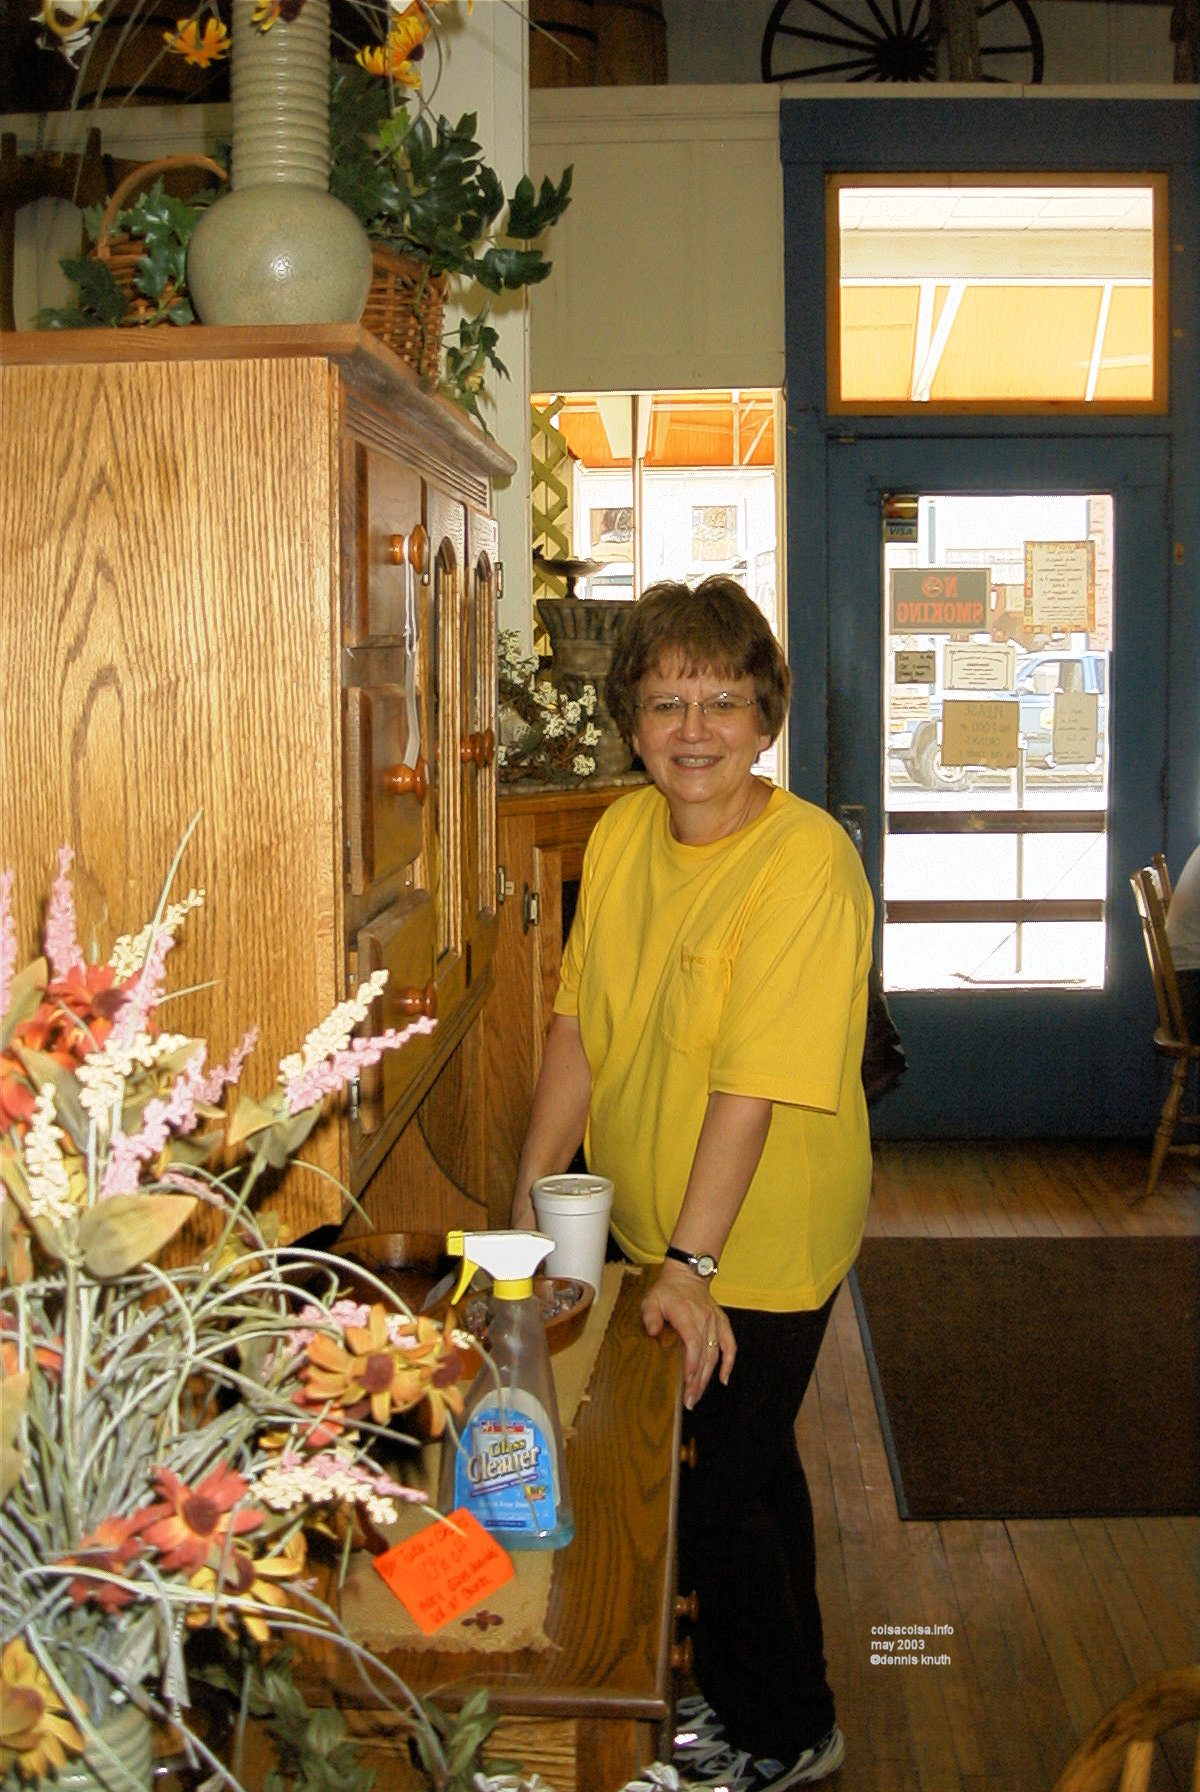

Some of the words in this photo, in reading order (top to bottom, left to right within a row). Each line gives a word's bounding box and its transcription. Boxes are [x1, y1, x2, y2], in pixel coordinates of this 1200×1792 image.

[889, 527, 913, 536] VISA
[489, 1440, 526, 1457] Glass
[467, 1447, 540, 1484] Cleaner
